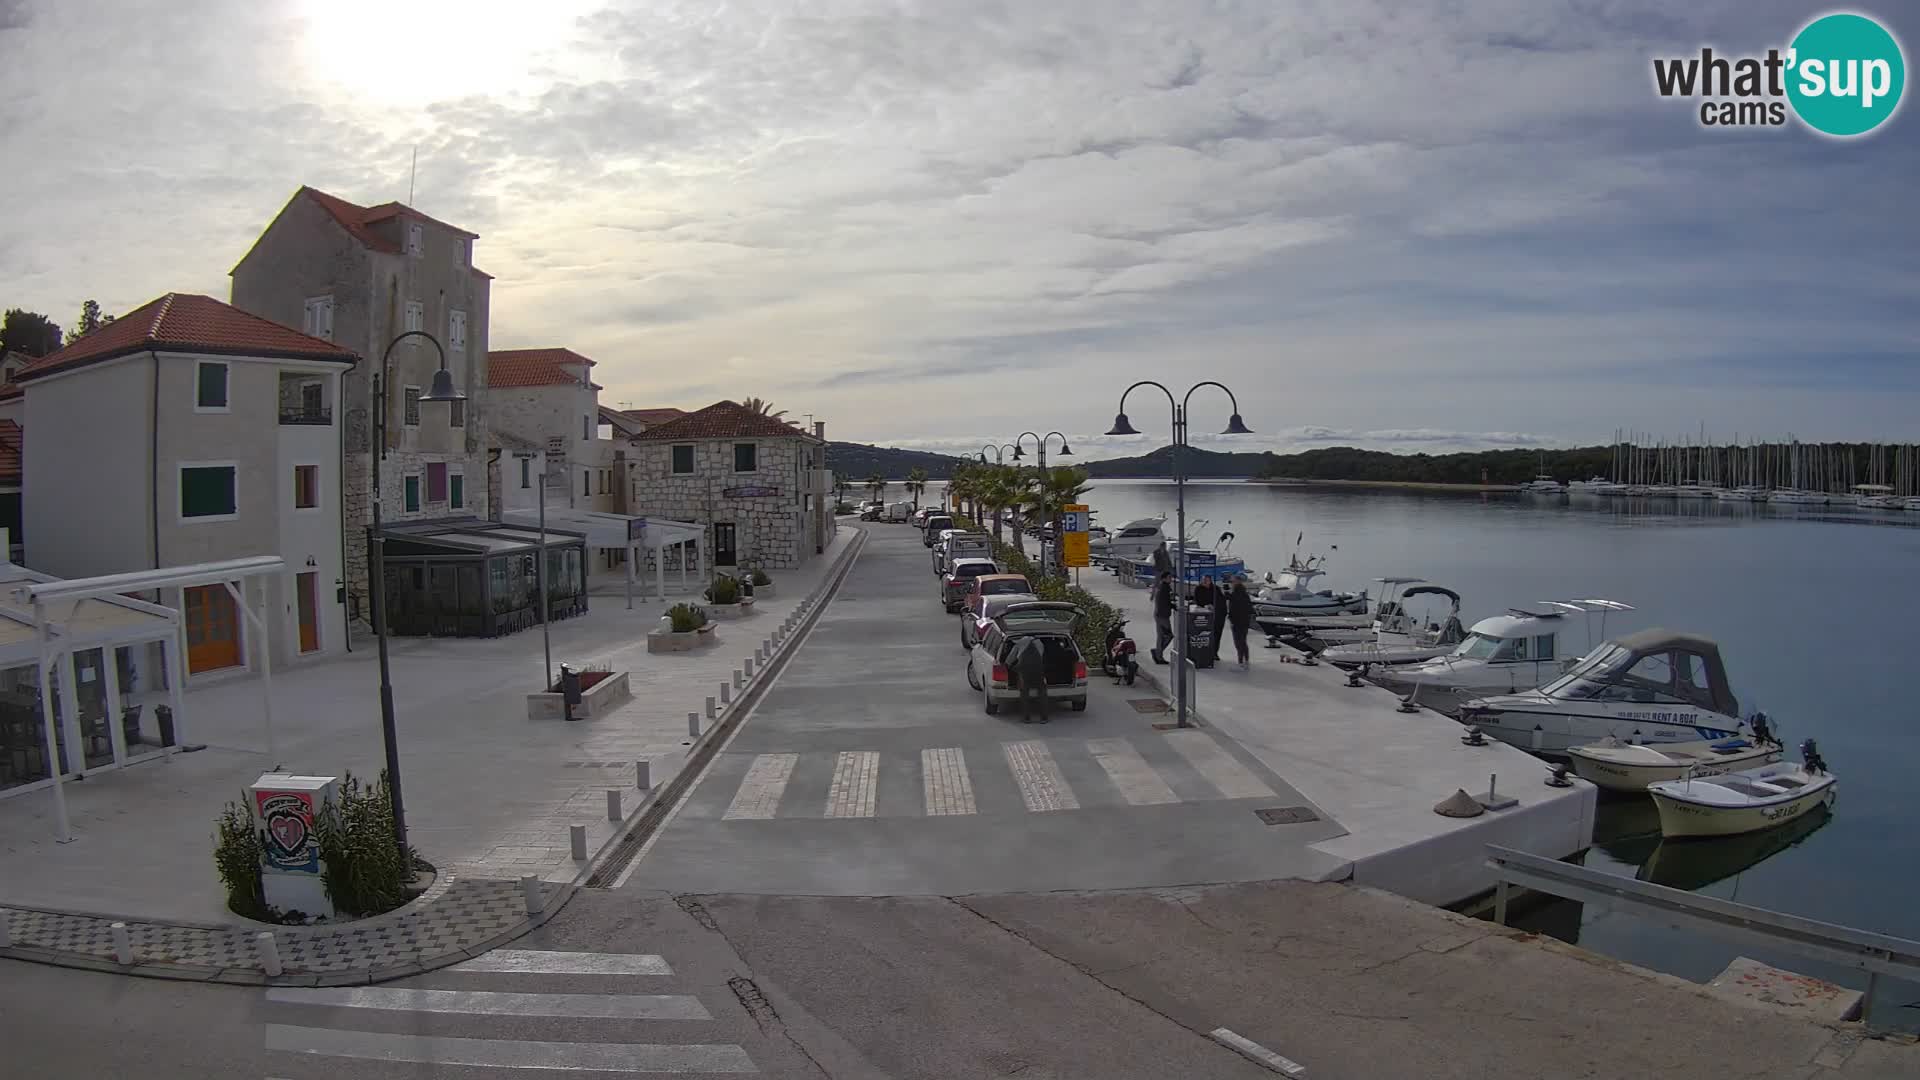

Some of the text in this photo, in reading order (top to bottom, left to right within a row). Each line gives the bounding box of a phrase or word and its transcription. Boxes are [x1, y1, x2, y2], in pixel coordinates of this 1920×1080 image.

[1652, 712, 1672, 722] RENT
[1672, 713, 1678, 722] A
[1679, 713, 1698, 725] BOAT
